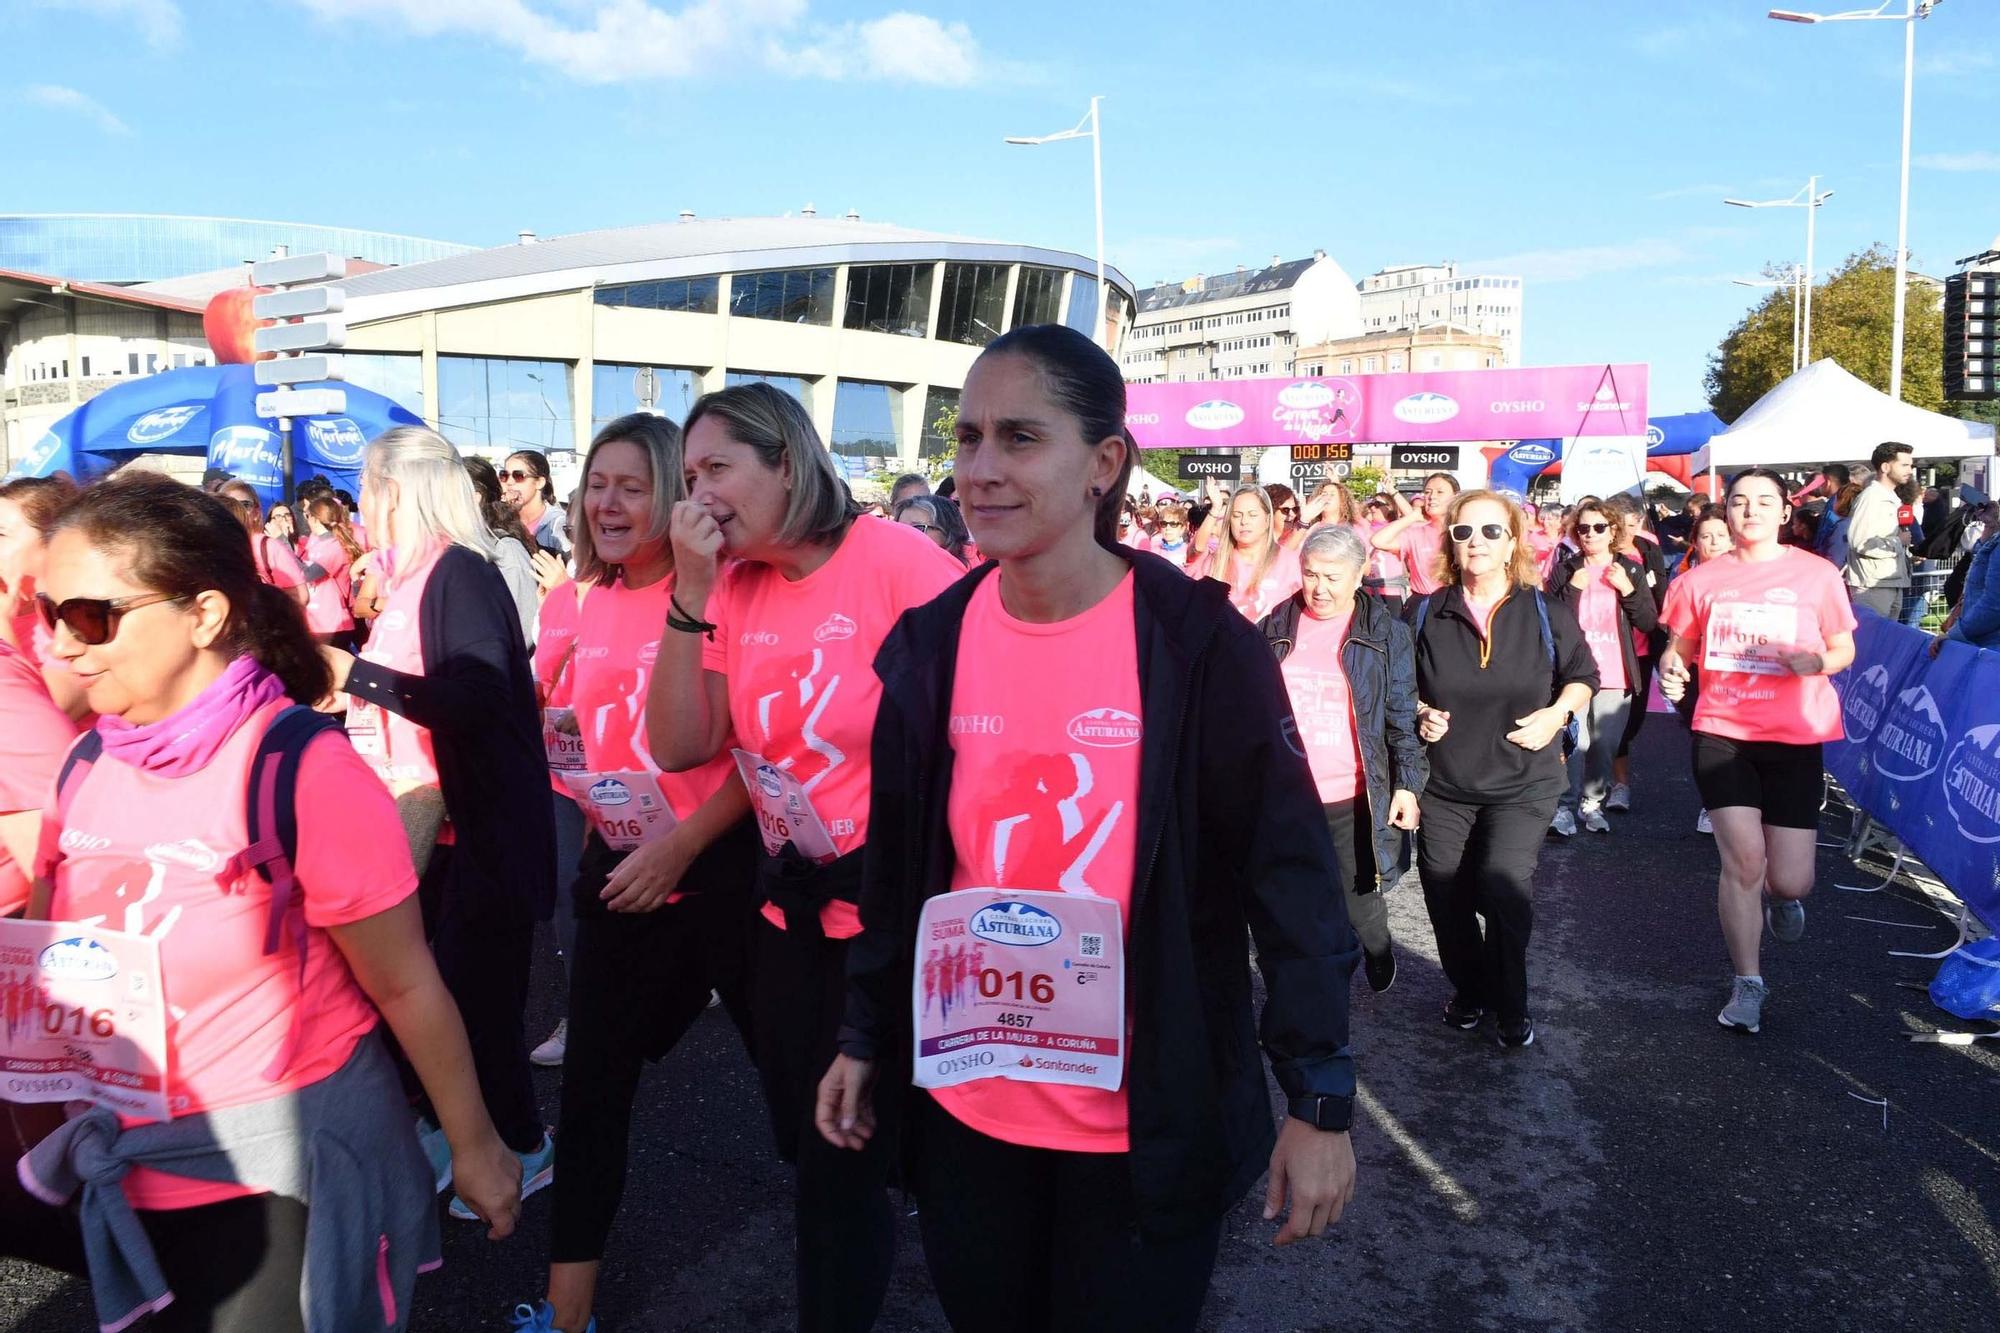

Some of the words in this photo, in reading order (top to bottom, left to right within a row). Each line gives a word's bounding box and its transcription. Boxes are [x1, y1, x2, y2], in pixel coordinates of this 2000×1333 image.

[1490, 401, 1545, 414] OYSHO
[1125, 413, 1160, 425] YSHO
[1401, 453, 1450, 464] OYSHO
[1187, 462, 1233, 474] OYSHO
[1073, 721, 1140, 738] ASTURIANA
[559, 739, 585, 753] 016
[1947, 759, 2000, 825] ASTURIAN
[603, 819, 642, 837] 016
[761, 810, 790, 837] 016
[931, 926, 966, 941] SUMA
[975, 915, 1055, 938] ASTURIANA
[978, 968, 1055, 1004] 016
[43, 1003, 115, 1038] 016
[997, 1012, 1034, 1029] 4857
[938, 1032, 975, 1050] CARRERA
[976, 1031, 990, 1041] DE
[991, 1030, 1004, 1041] LA
[1006, 1031, 1038, 1044] MUJER
[1046, 1036, 1055, 1047] A
[1056, 1036, 1098, 1051] CORUÑA
[936, 1051, 995, 1076] OYSHO
[1035, 1057, 1099, 1075] Santander
